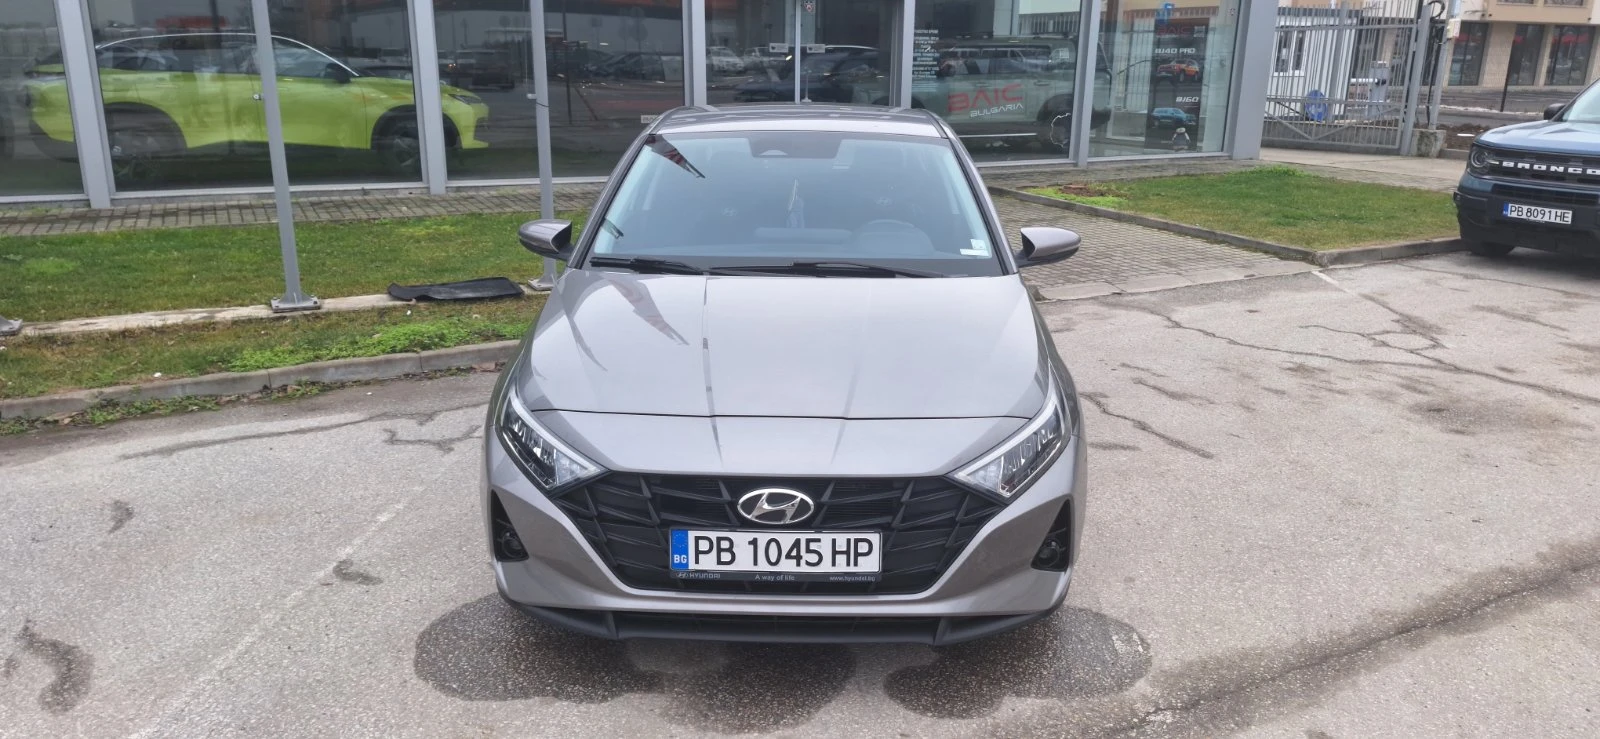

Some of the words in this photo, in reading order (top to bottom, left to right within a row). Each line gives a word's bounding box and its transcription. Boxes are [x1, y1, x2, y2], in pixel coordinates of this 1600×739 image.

[948, 82, 1024, 112] BAIC
[970, 102, 1024, 118] BULGARIA
[1502, 161, 1600, 175] BRONCO
[1509, 205, 1524, 217] PB
[1526, 207, 1552, 220] 8091
[1554, 210, 1570, 223] HE
[673, 554, 688, 564] BG
[694, 536, 736, 566] PB
[748, 537, 824, 567] 1045
[831, 537, 874, 567] HP
